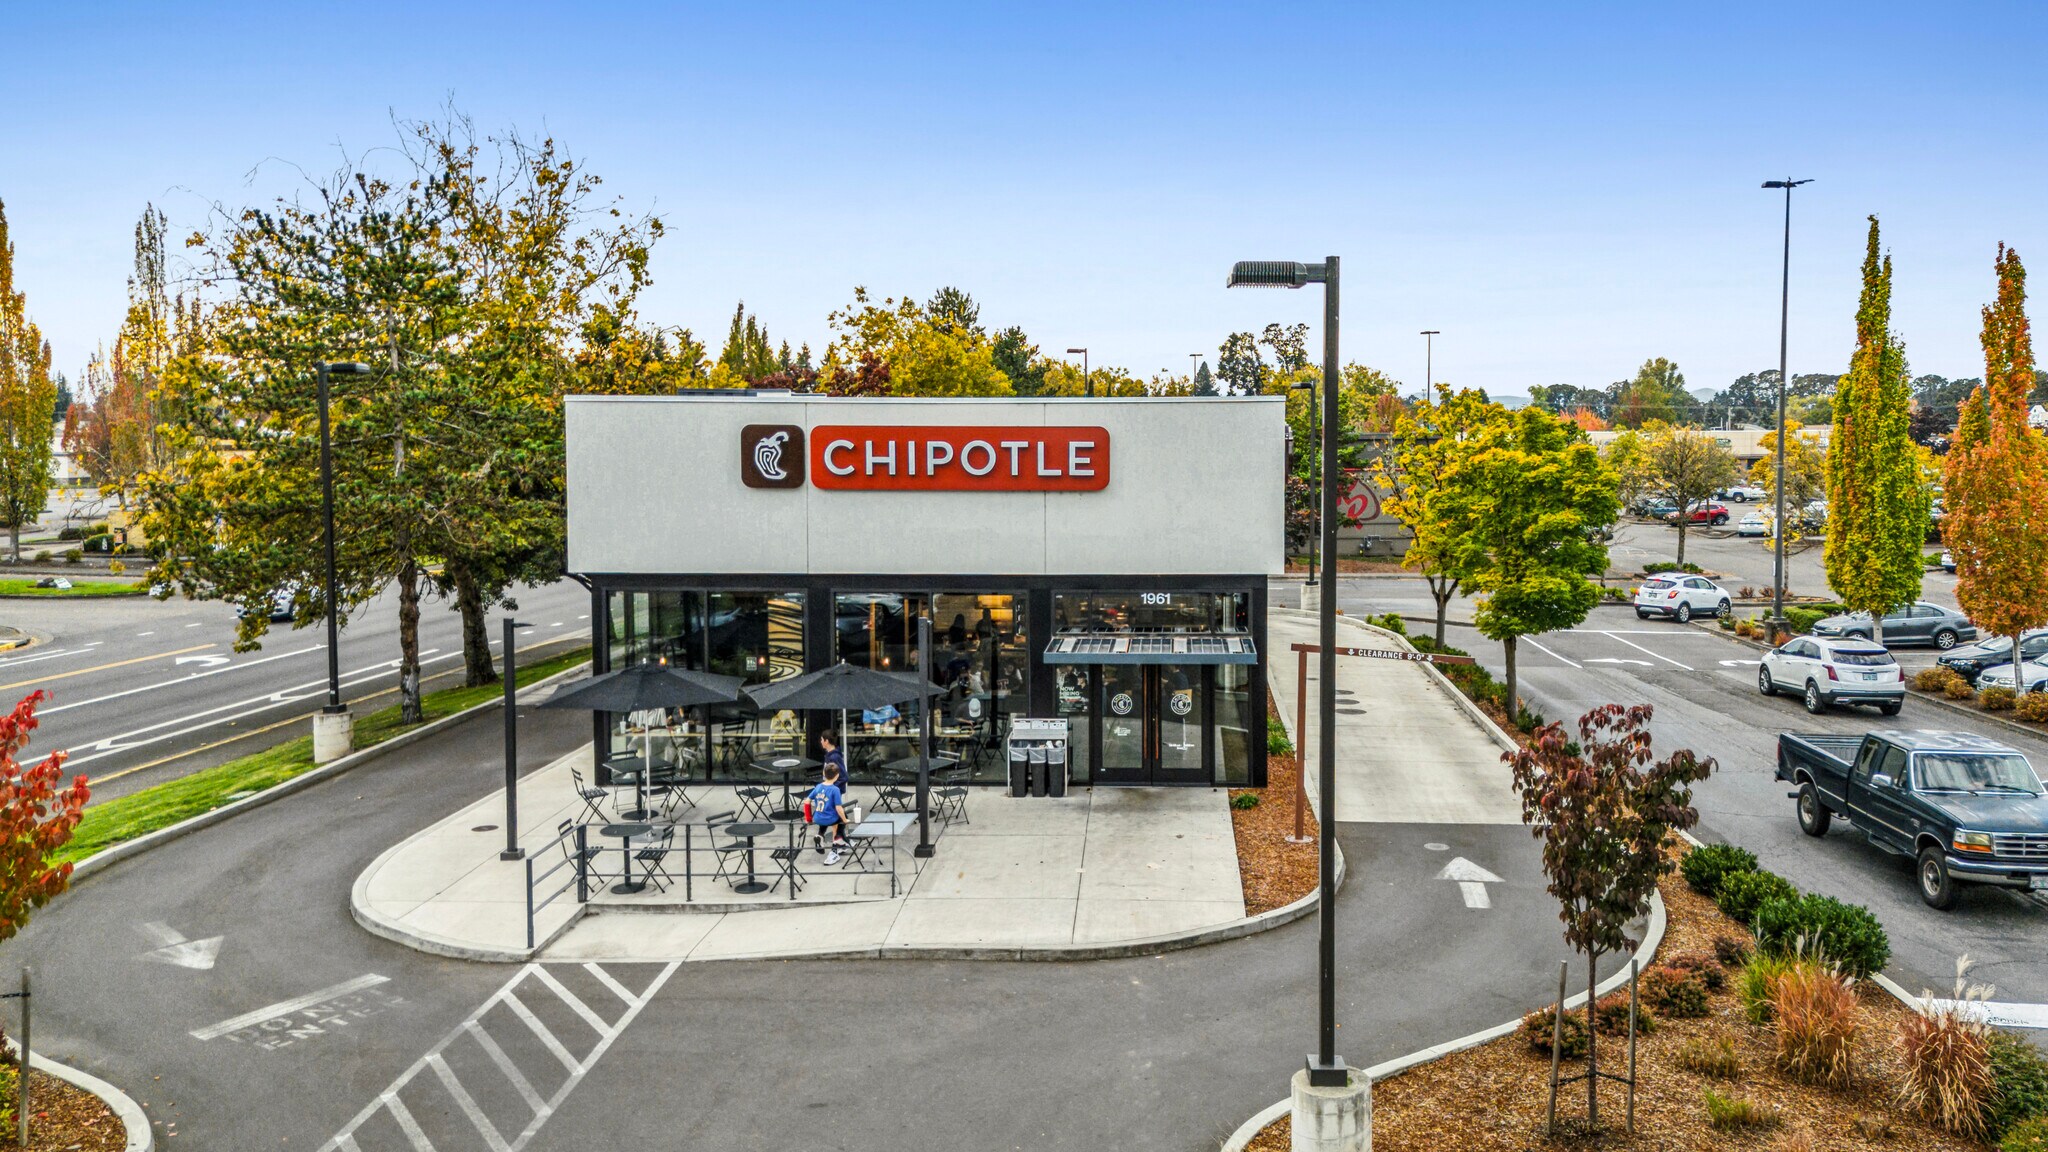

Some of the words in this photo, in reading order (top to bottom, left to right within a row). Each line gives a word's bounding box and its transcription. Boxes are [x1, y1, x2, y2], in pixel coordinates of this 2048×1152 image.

[823, 439, 1096, 477] CHIPOTLE
[1140, 592, 1171, 605] 1961
[1358, 649, 1403, 660] CLEARANCE
